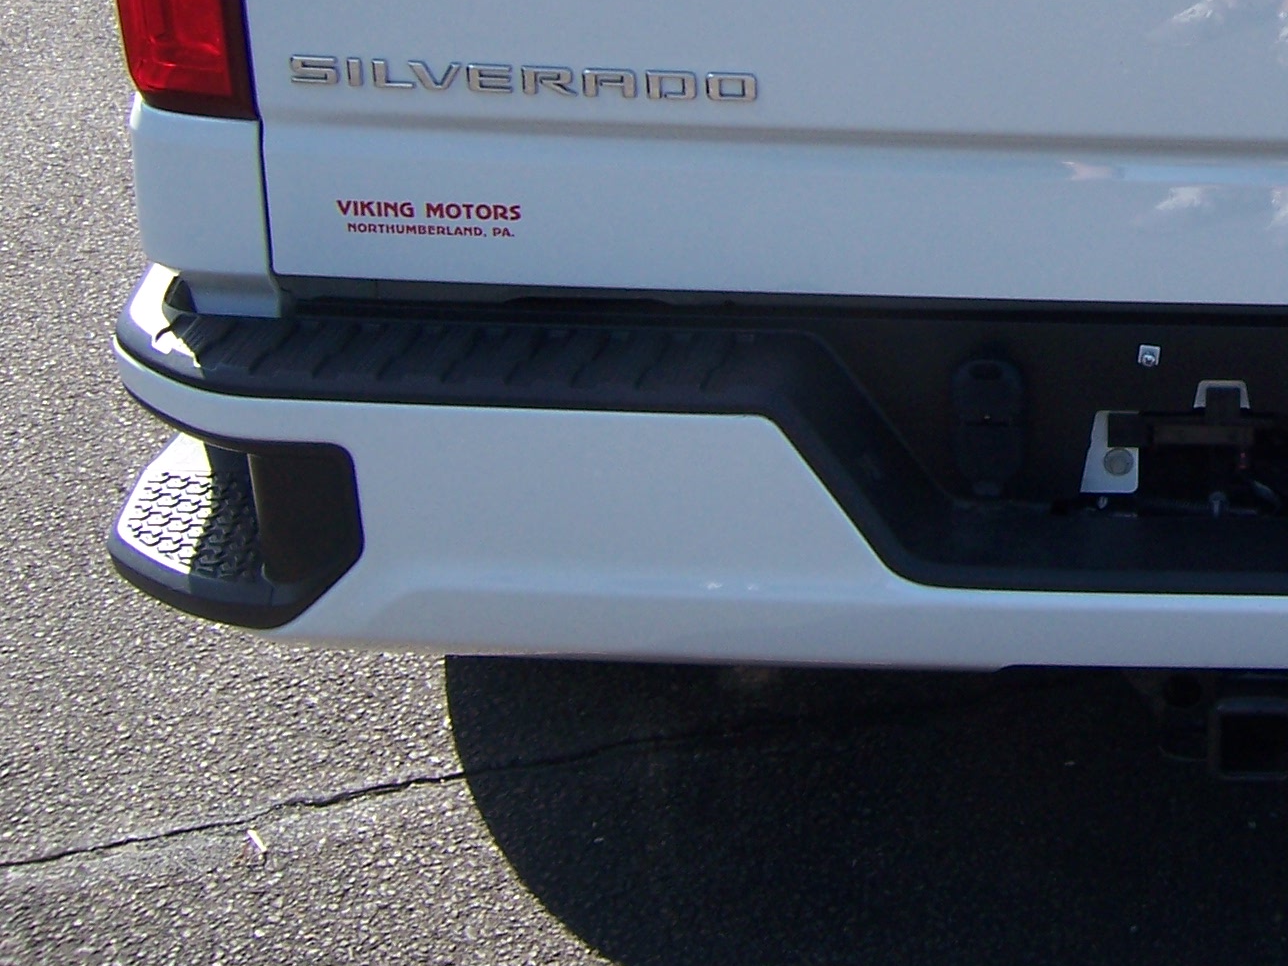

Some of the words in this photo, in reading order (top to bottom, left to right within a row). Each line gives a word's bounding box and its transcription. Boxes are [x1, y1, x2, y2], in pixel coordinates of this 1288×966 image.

[289, 54, 758, 102] SILVERADO
[336, 199, 415, 218] VIKING
[425, 202, 522, 221] MOTORS
[347, 222, 488, 238] NORTHUMBERLAND,
[492, 227, 515, 238] PA.
